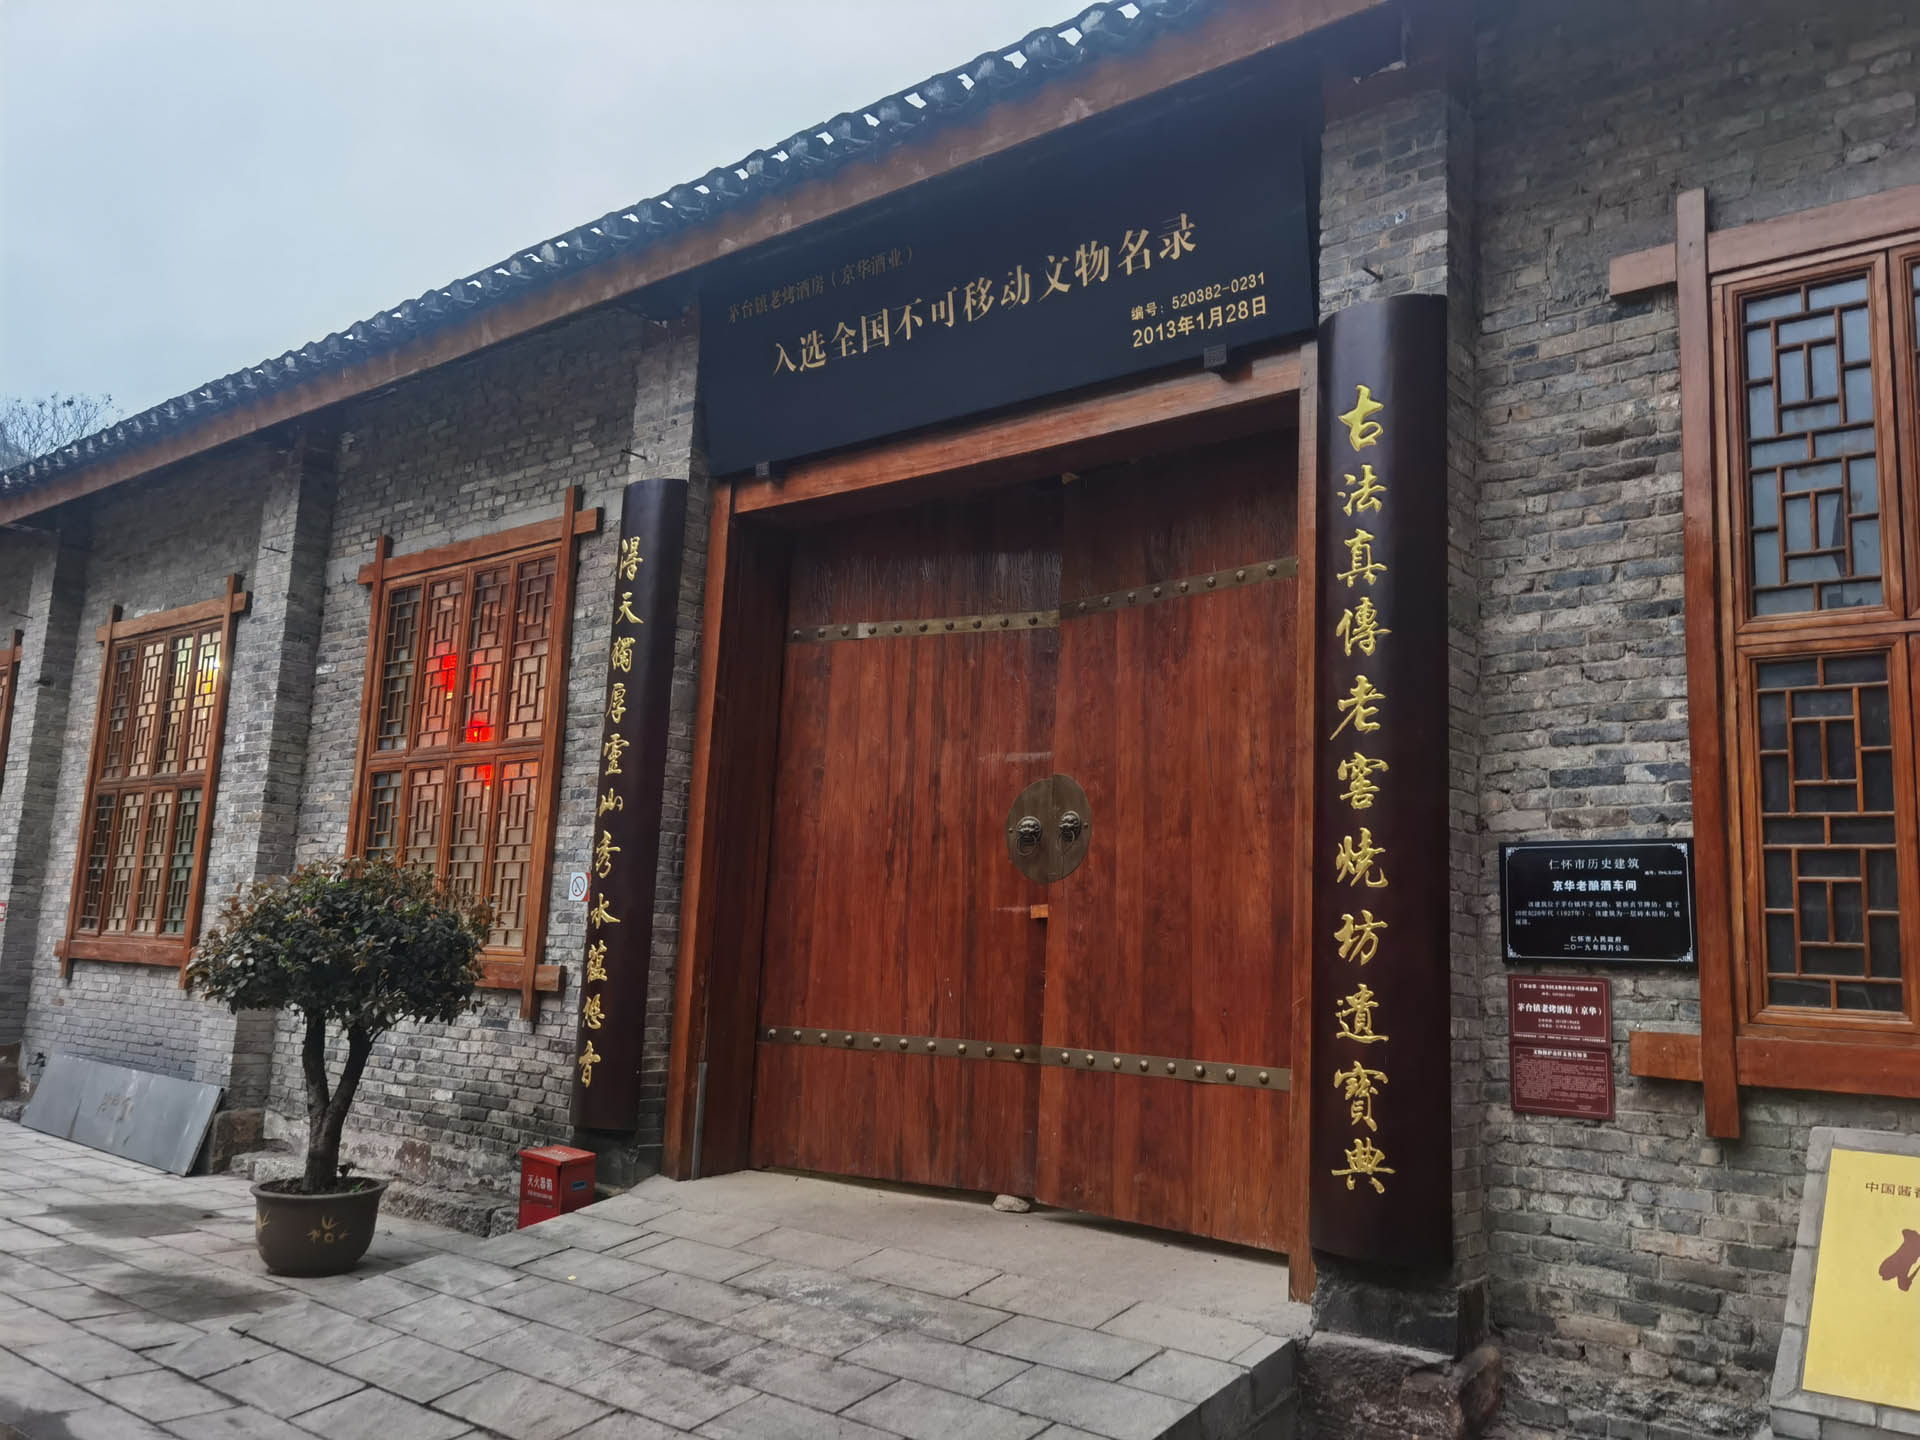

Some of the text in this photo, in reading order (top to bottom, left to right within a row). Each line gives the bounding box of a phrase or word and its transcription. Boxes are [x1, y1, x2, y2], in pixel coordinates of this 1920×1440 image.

[771, 212, 1197, 377] 入选全国不可移动文物名录
[1132, 295, 1268, 349] 2013年1月28日
[1549, 858, 1640, 870] 仁怀市历史建筑
[1552, 880, 1637, 892] 京华老酿酒车间
